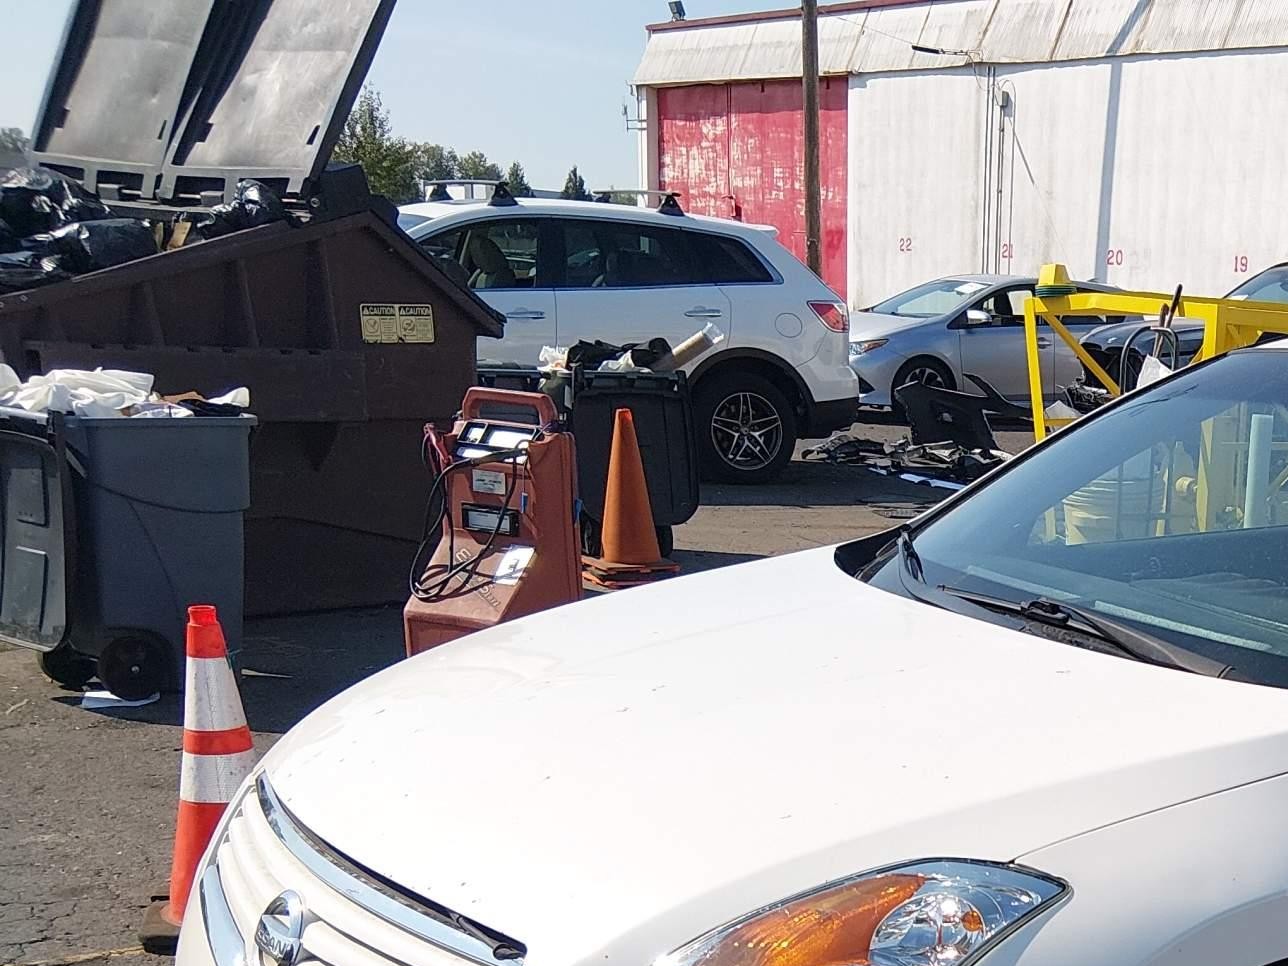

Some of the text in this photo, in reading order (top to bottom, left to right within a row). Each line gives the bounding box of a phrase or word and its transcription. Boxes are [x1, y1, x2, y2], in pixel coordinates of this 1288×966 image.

[899, 238, 912, 252] 22
[1002, 243, 1014, 258] 21
[1106, 250, 1123, 265] 20
[1234, 255, 1248, 272] 19
